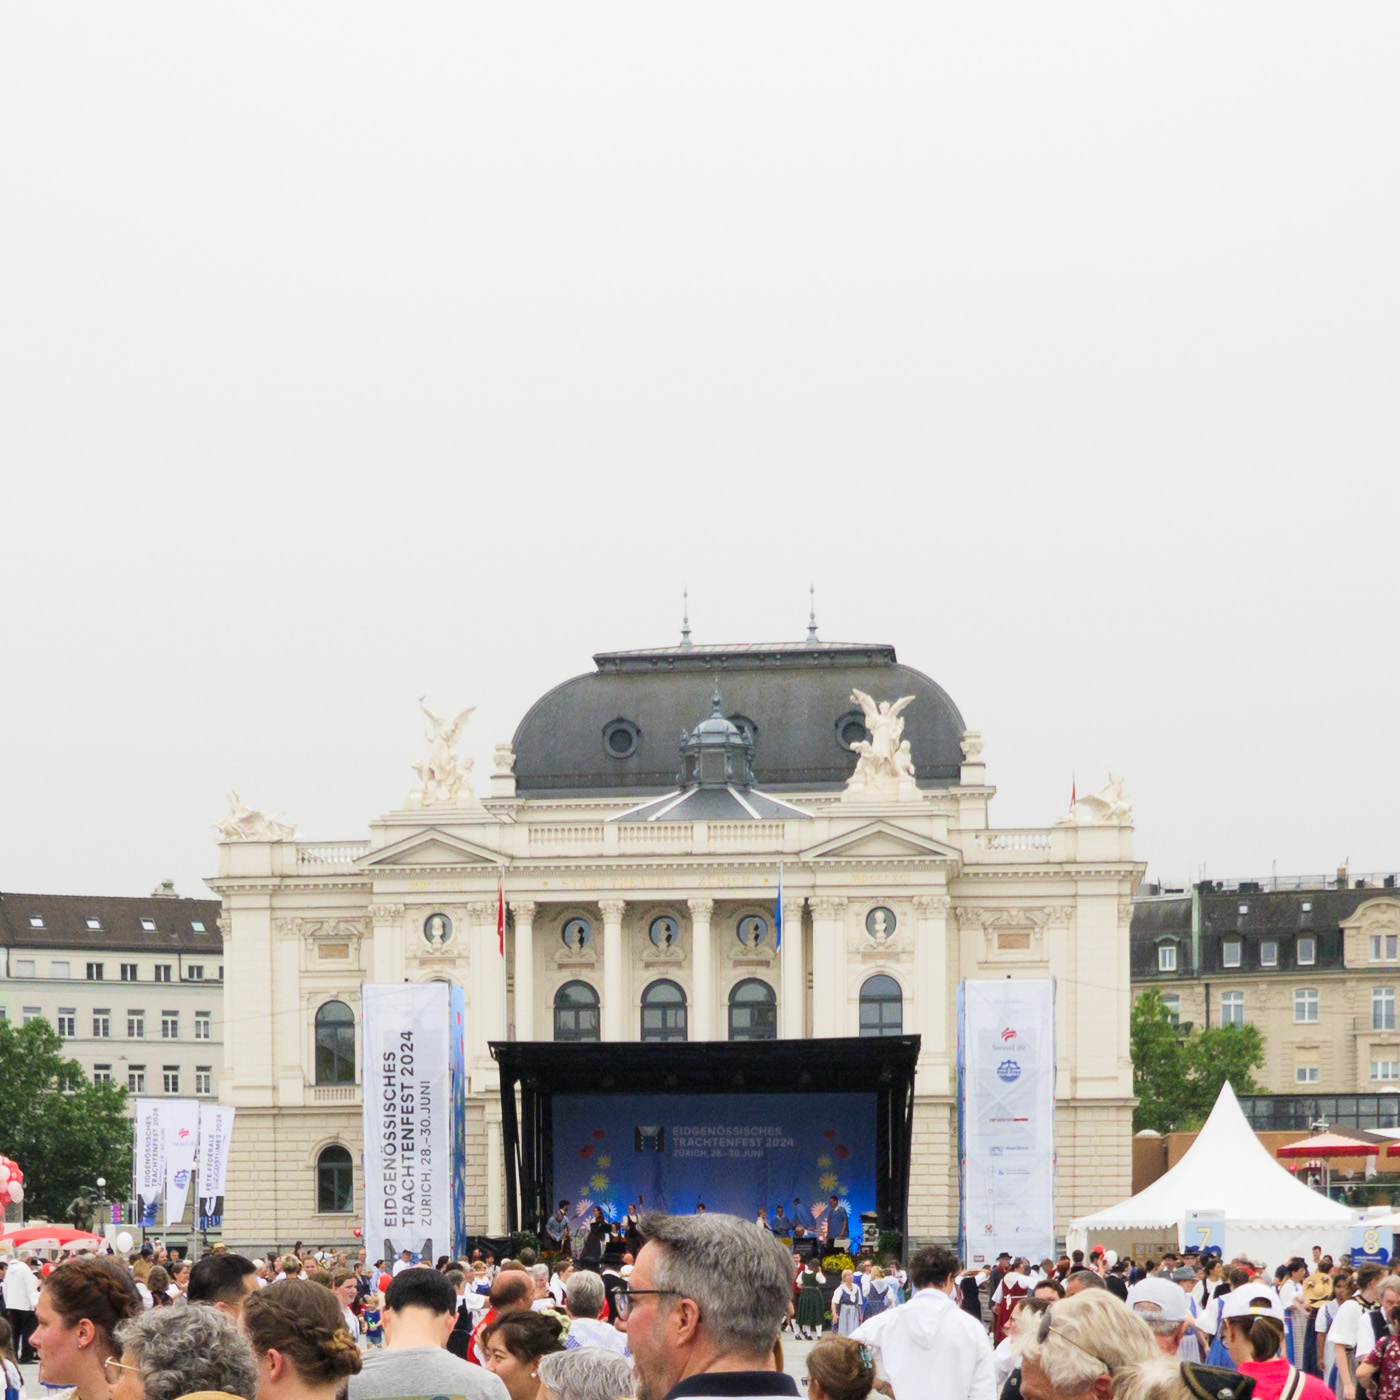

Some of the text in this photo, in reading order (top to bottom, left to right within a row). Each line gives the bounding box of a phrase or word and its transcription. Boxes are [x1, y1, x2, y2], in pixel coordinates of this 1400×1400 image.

[151, 1107, 160, 1188] TRACHTENFEST 2024
[380, 1051, 397, 1228] EIDGENÖSSISCHES
[400, 1030, 415, 1228] TRACHTENFEST 2024
[672, 1125, 782, 1137] EIDGENÖSSISCHES
[672, 1137, 795, 1148] TRACHTENFEST 2024
[419, 1168, 432, 1226] ZÜRICH,
[1196, 1226, 1213, 1251] 7
[1362, 1228, 1380, 1255] 8
